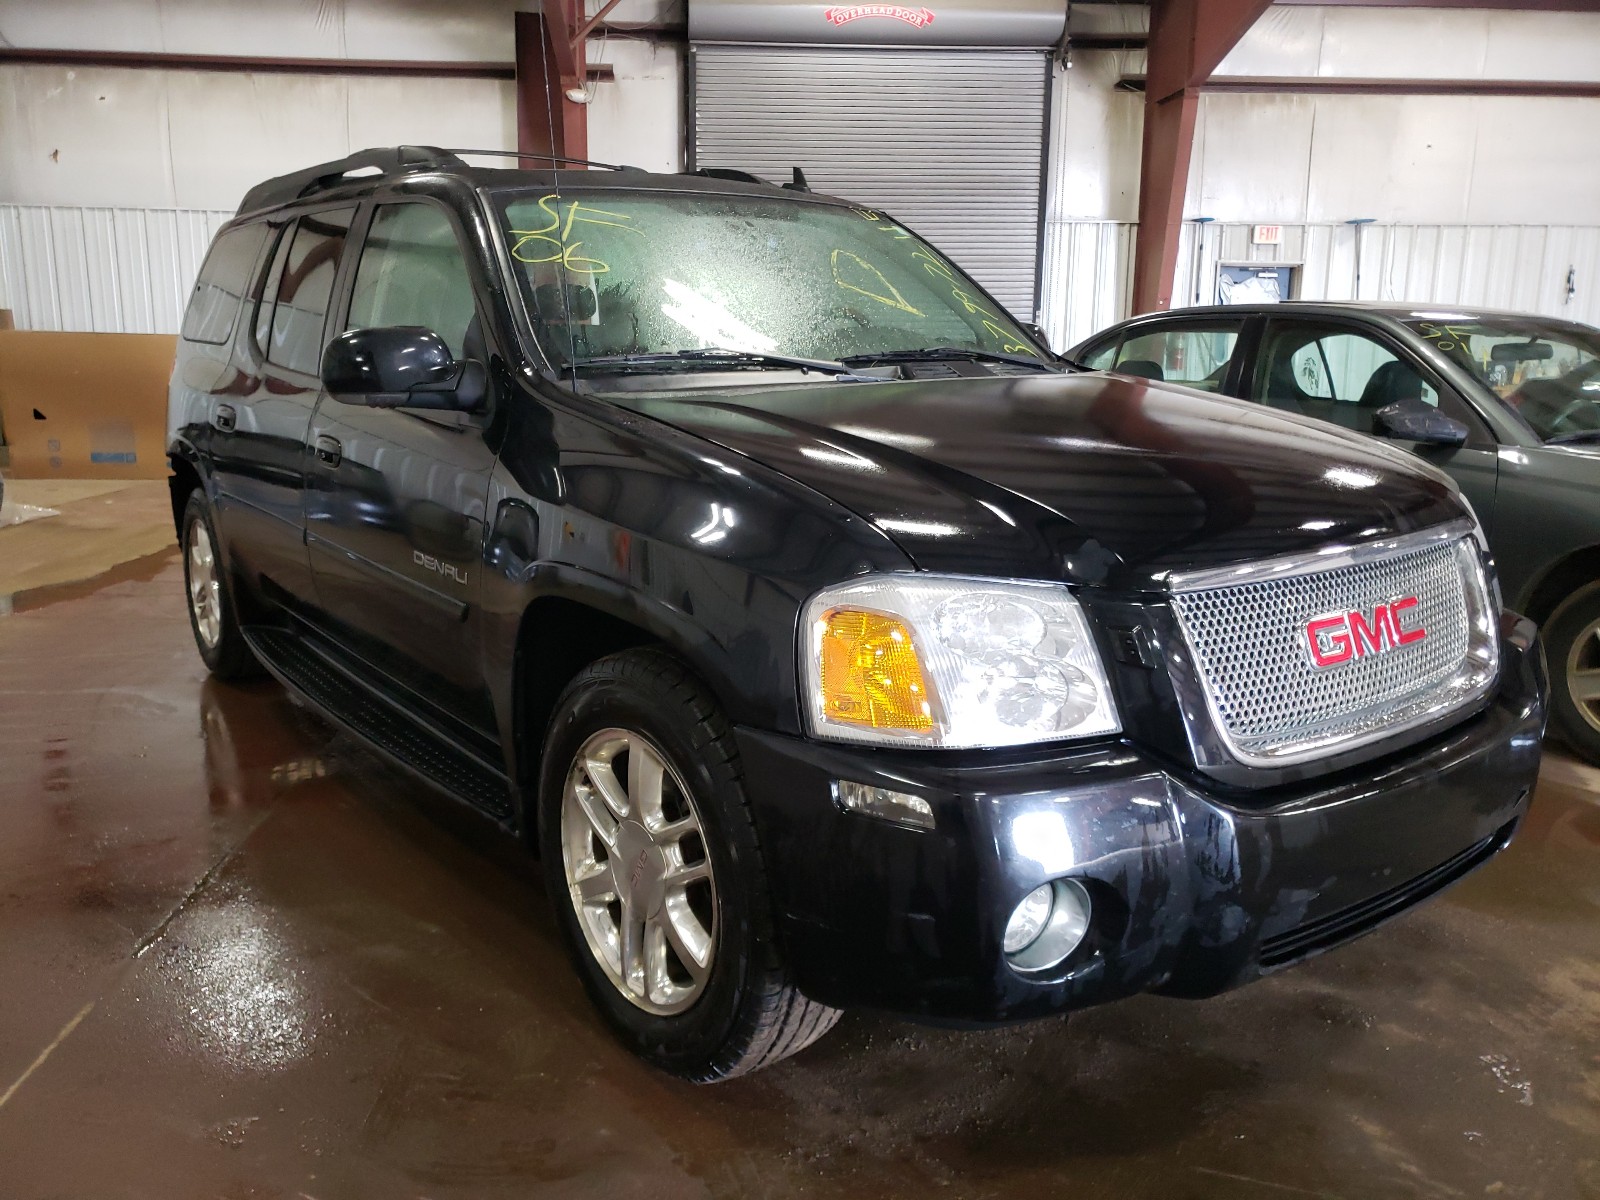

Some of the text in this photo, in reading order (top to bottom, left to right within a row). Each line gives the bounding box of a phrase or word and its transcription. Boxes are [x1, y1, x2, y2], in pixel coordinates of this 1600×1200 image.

[836, 6, 923, 26] OVERHEAD DOOR
[1259, 226, 1280, 241] EXIT
[511, 235, 610, 273] 06
[413, 550, 468, 585] DENALI
[1306, 596, 1427, 667] GMC
